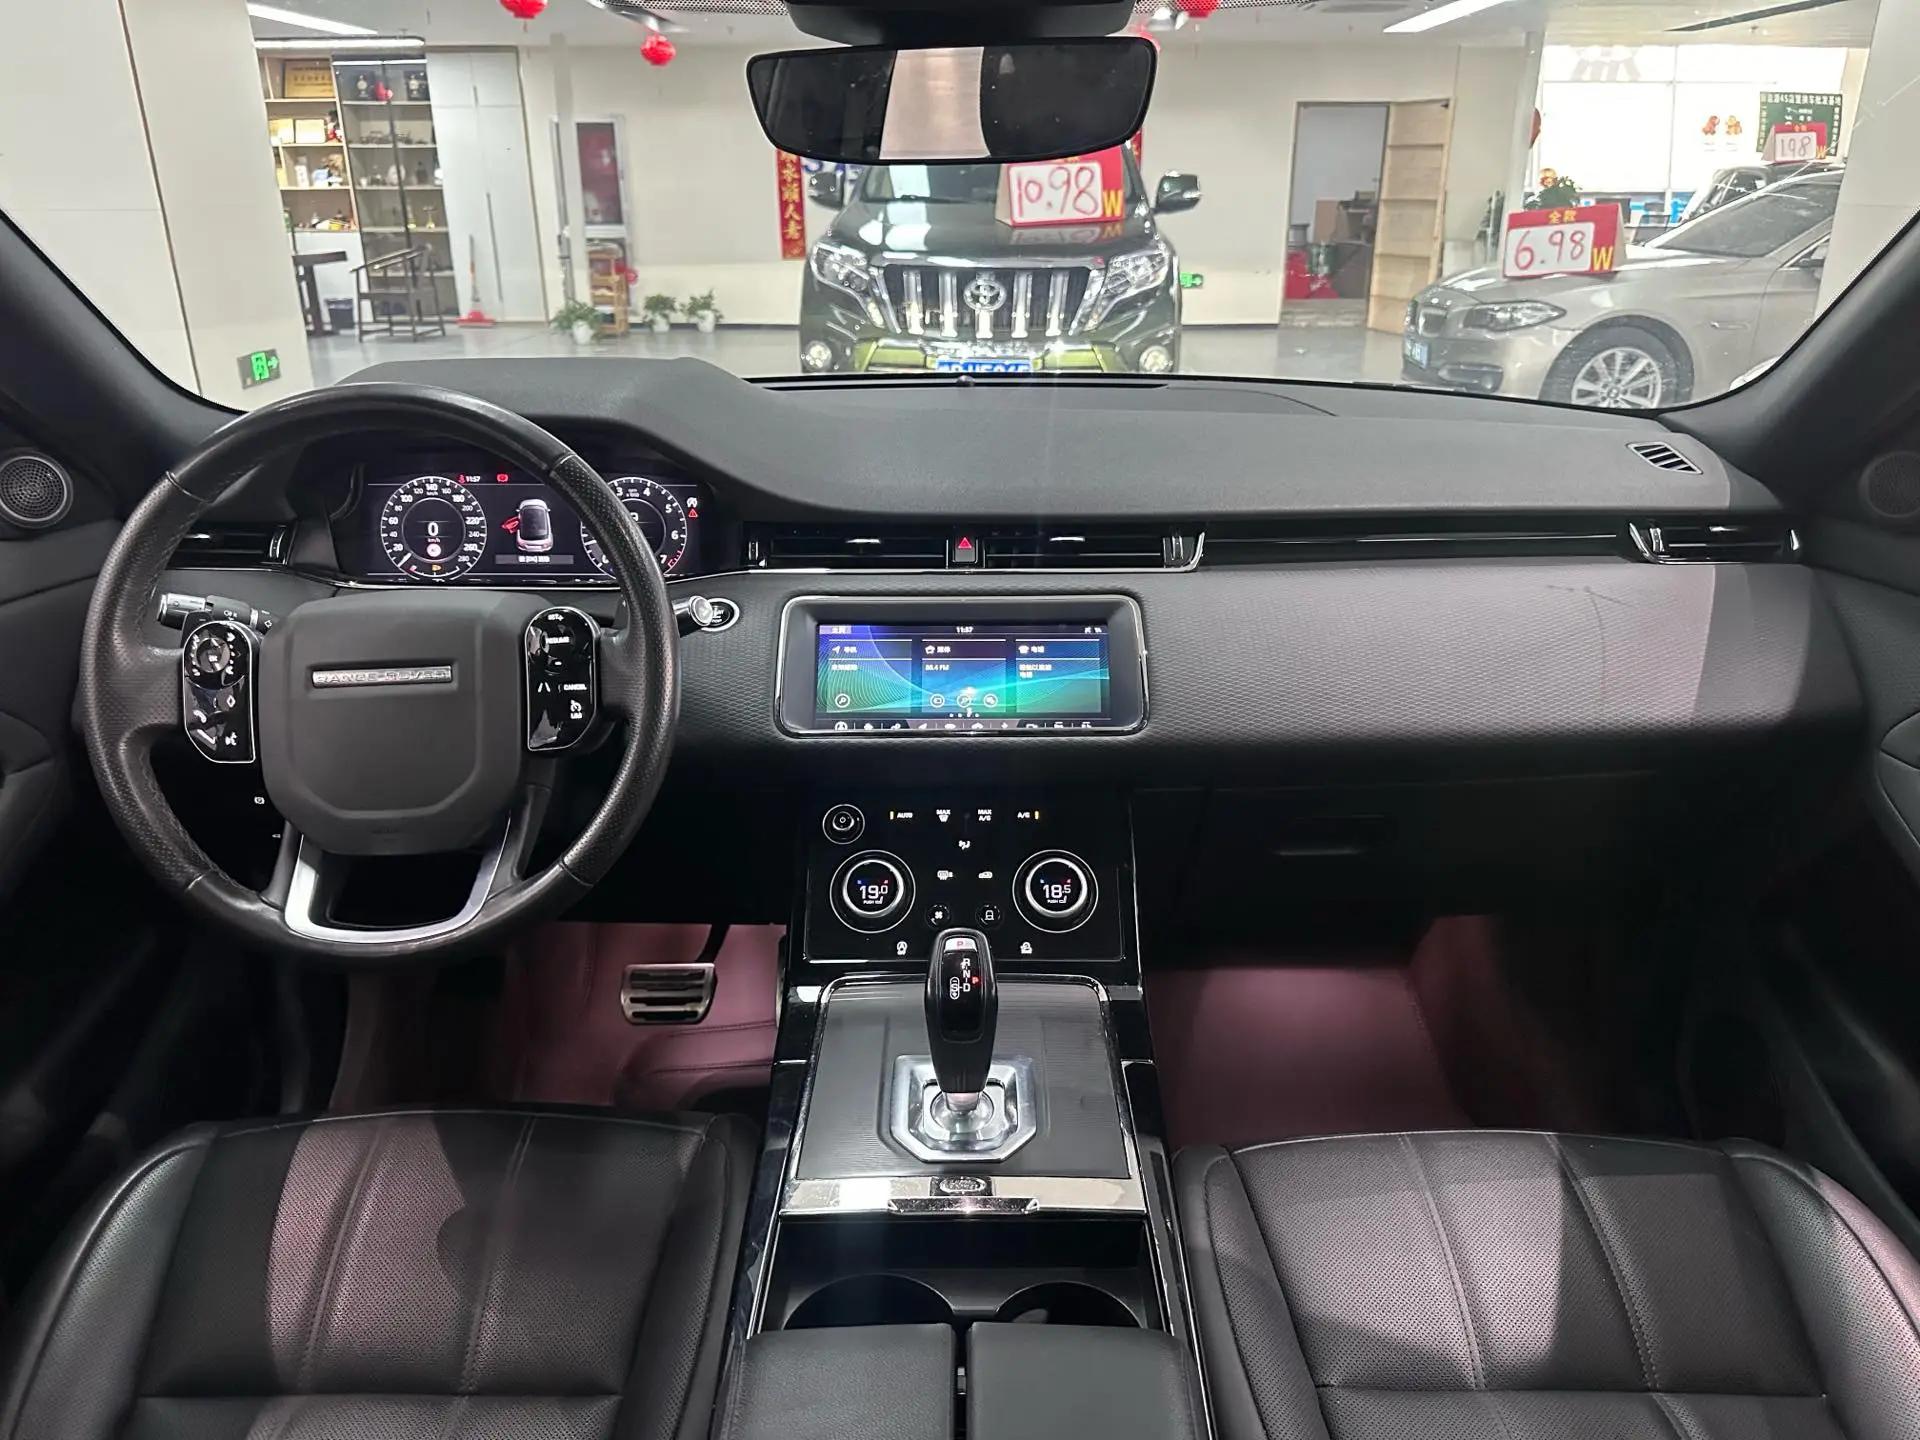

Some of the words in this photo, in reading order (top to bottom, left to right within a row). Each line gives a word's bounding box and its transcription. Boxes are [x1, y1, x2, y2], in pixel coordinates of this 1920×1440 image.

[1017, 166, 1099, 217] 10.98
[1103, 189, 1123, 217] W
[1548, 209, 1577, 224] 全款
[1514, 229, 1586, 271] 6.98
[1592, 246, 1613, 271] W
[616, 487, 623, 496] 3
[643, 487, 651, 496] 4
[400, 494, 413, 502] 100
[665, 504, 672, 513] 5
[388, 517, 399, 525] 60
[427, 522, 438, 536] 0
[671, 530, 679, 540] 6
[393, 543, 404, 551] 20
[660, 554, 667, 564] 7
[896, 811, 913, 819] AUTO
[859, 885, 889, 900] 19.0
[1042, 884, 1072, 899] 18.5
[963, 957, 971, 967] R
[962, 969, 971, 978] N
[962, 982, 971, 992] D
